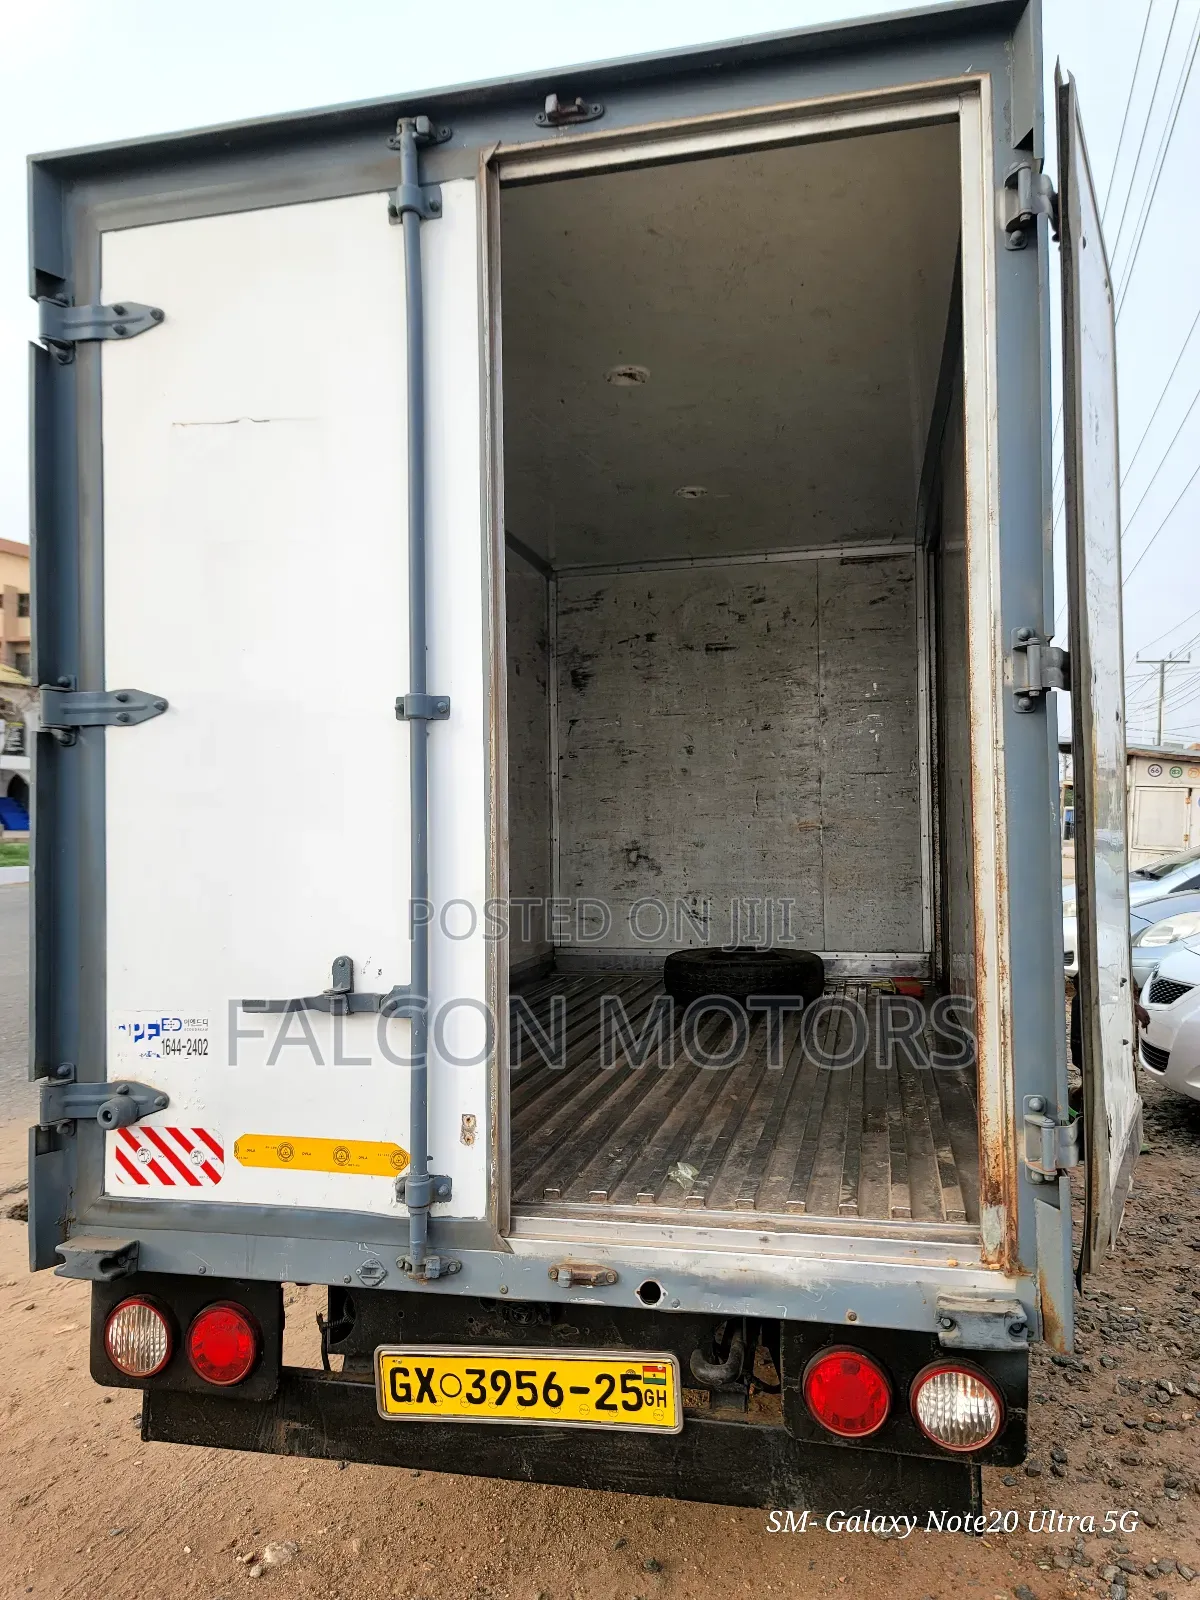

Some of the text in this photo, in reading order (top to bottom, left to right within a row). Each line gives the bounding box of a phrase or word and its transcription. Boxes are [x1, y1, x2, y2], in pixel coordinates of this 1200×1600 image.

[161, 1038, 209, 1056] 1644-2402
[390, 1367, 643, 1412] GX 3956-25
[644, 1388, 667, 1408] GH
